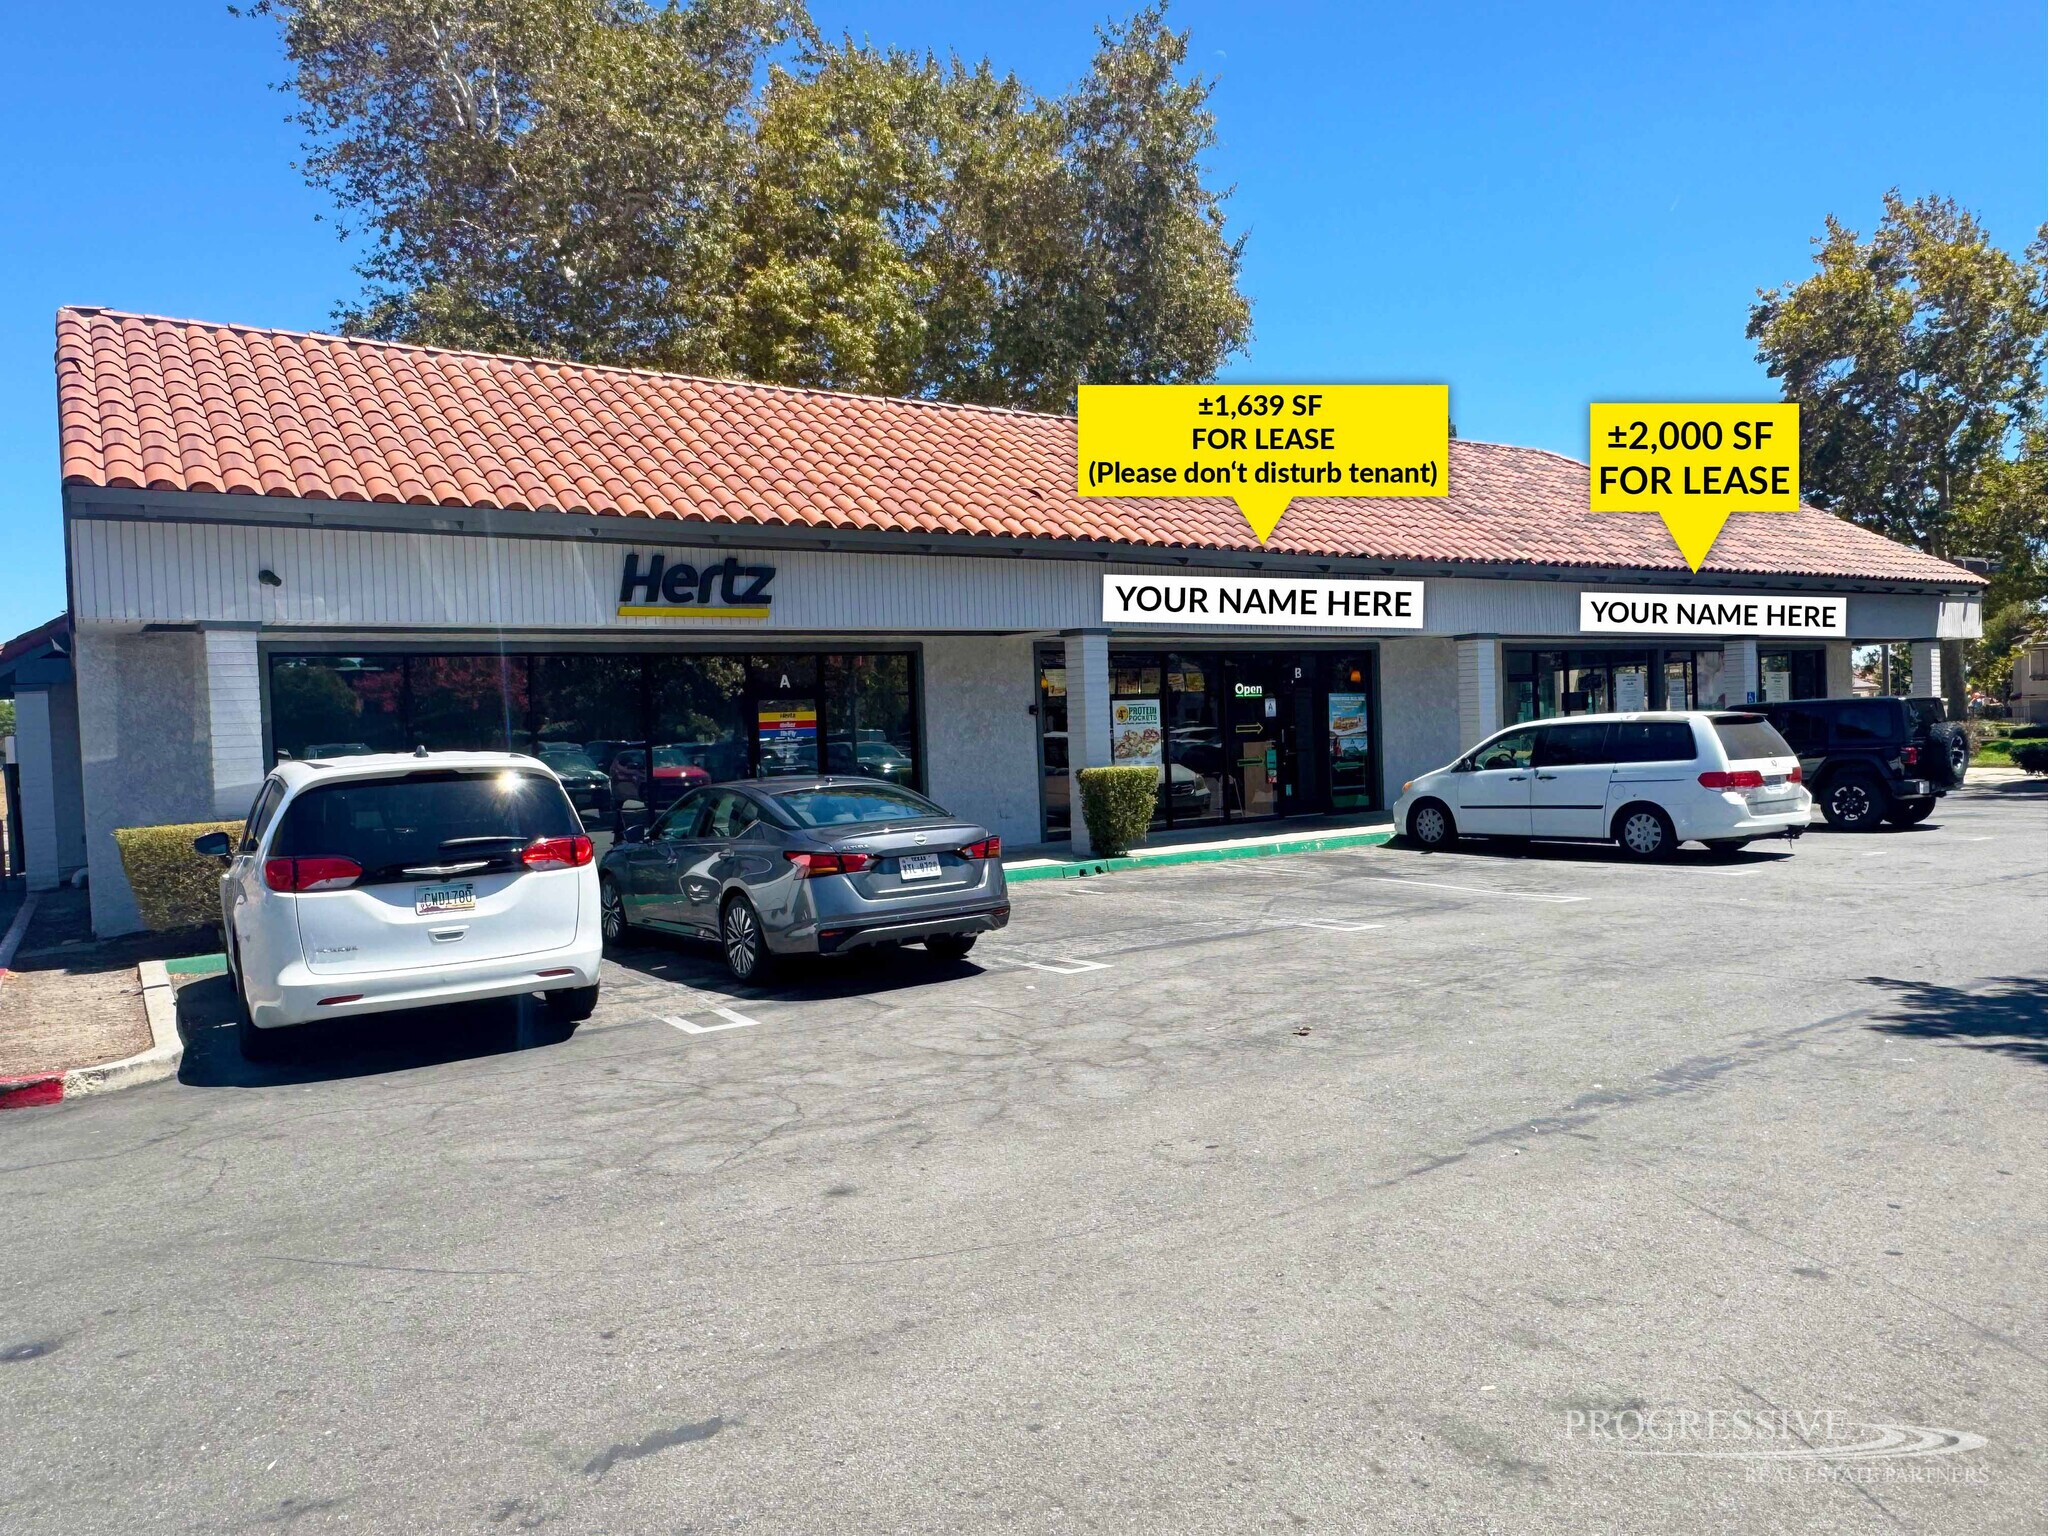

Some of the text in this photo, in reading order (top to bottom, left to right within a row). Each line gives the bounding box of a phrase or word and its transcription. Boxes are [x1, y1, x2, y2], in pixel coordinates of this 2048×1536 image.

[618, 554, 777, 605] Hertz
[1294, 667, 1302, 679] B
[780, 674, 791, 689] A
[1235, 683, 1263, 697] Open
